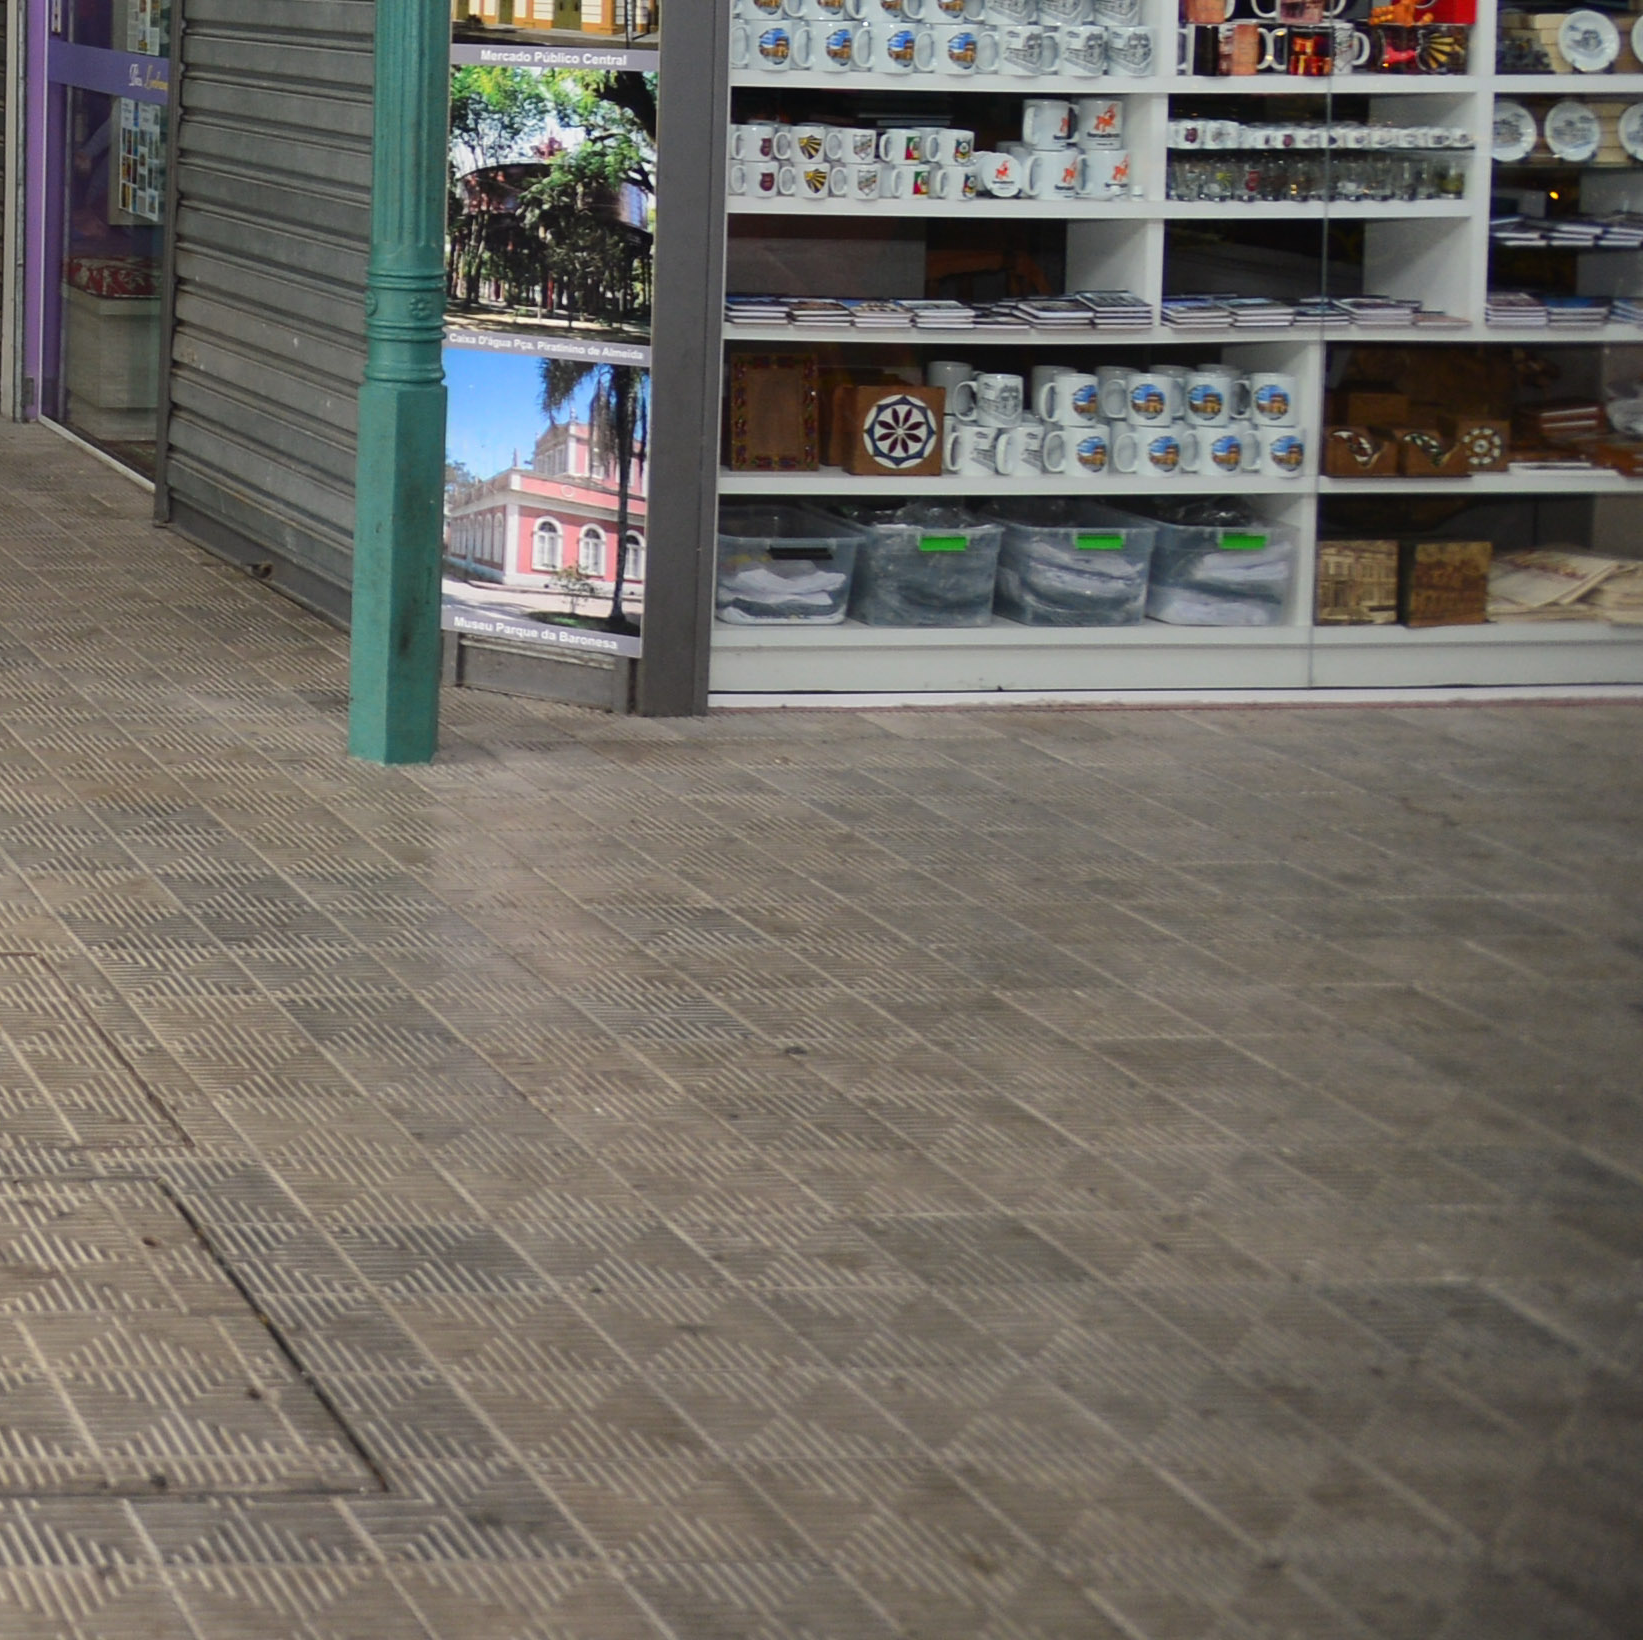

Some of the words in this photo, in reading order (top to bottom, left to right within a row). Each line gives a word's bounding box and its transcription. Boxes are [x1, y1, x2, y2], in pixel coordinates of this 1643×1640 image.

[481, 49, 531, 62] Mercado
[534, 50, 580, 64] Público
[582, 53, 627, 66] Central
[449, 333, 476, 345] Caixa
[587, 345, 600, 356] de
[602, 347, 644, 360] Almeida
[453, 616, 493, 633] Museu
[496, 622, 538, 641] Parque
[541, 628, 557, 641] da
[560, 631, 618, 650] Baronesa
